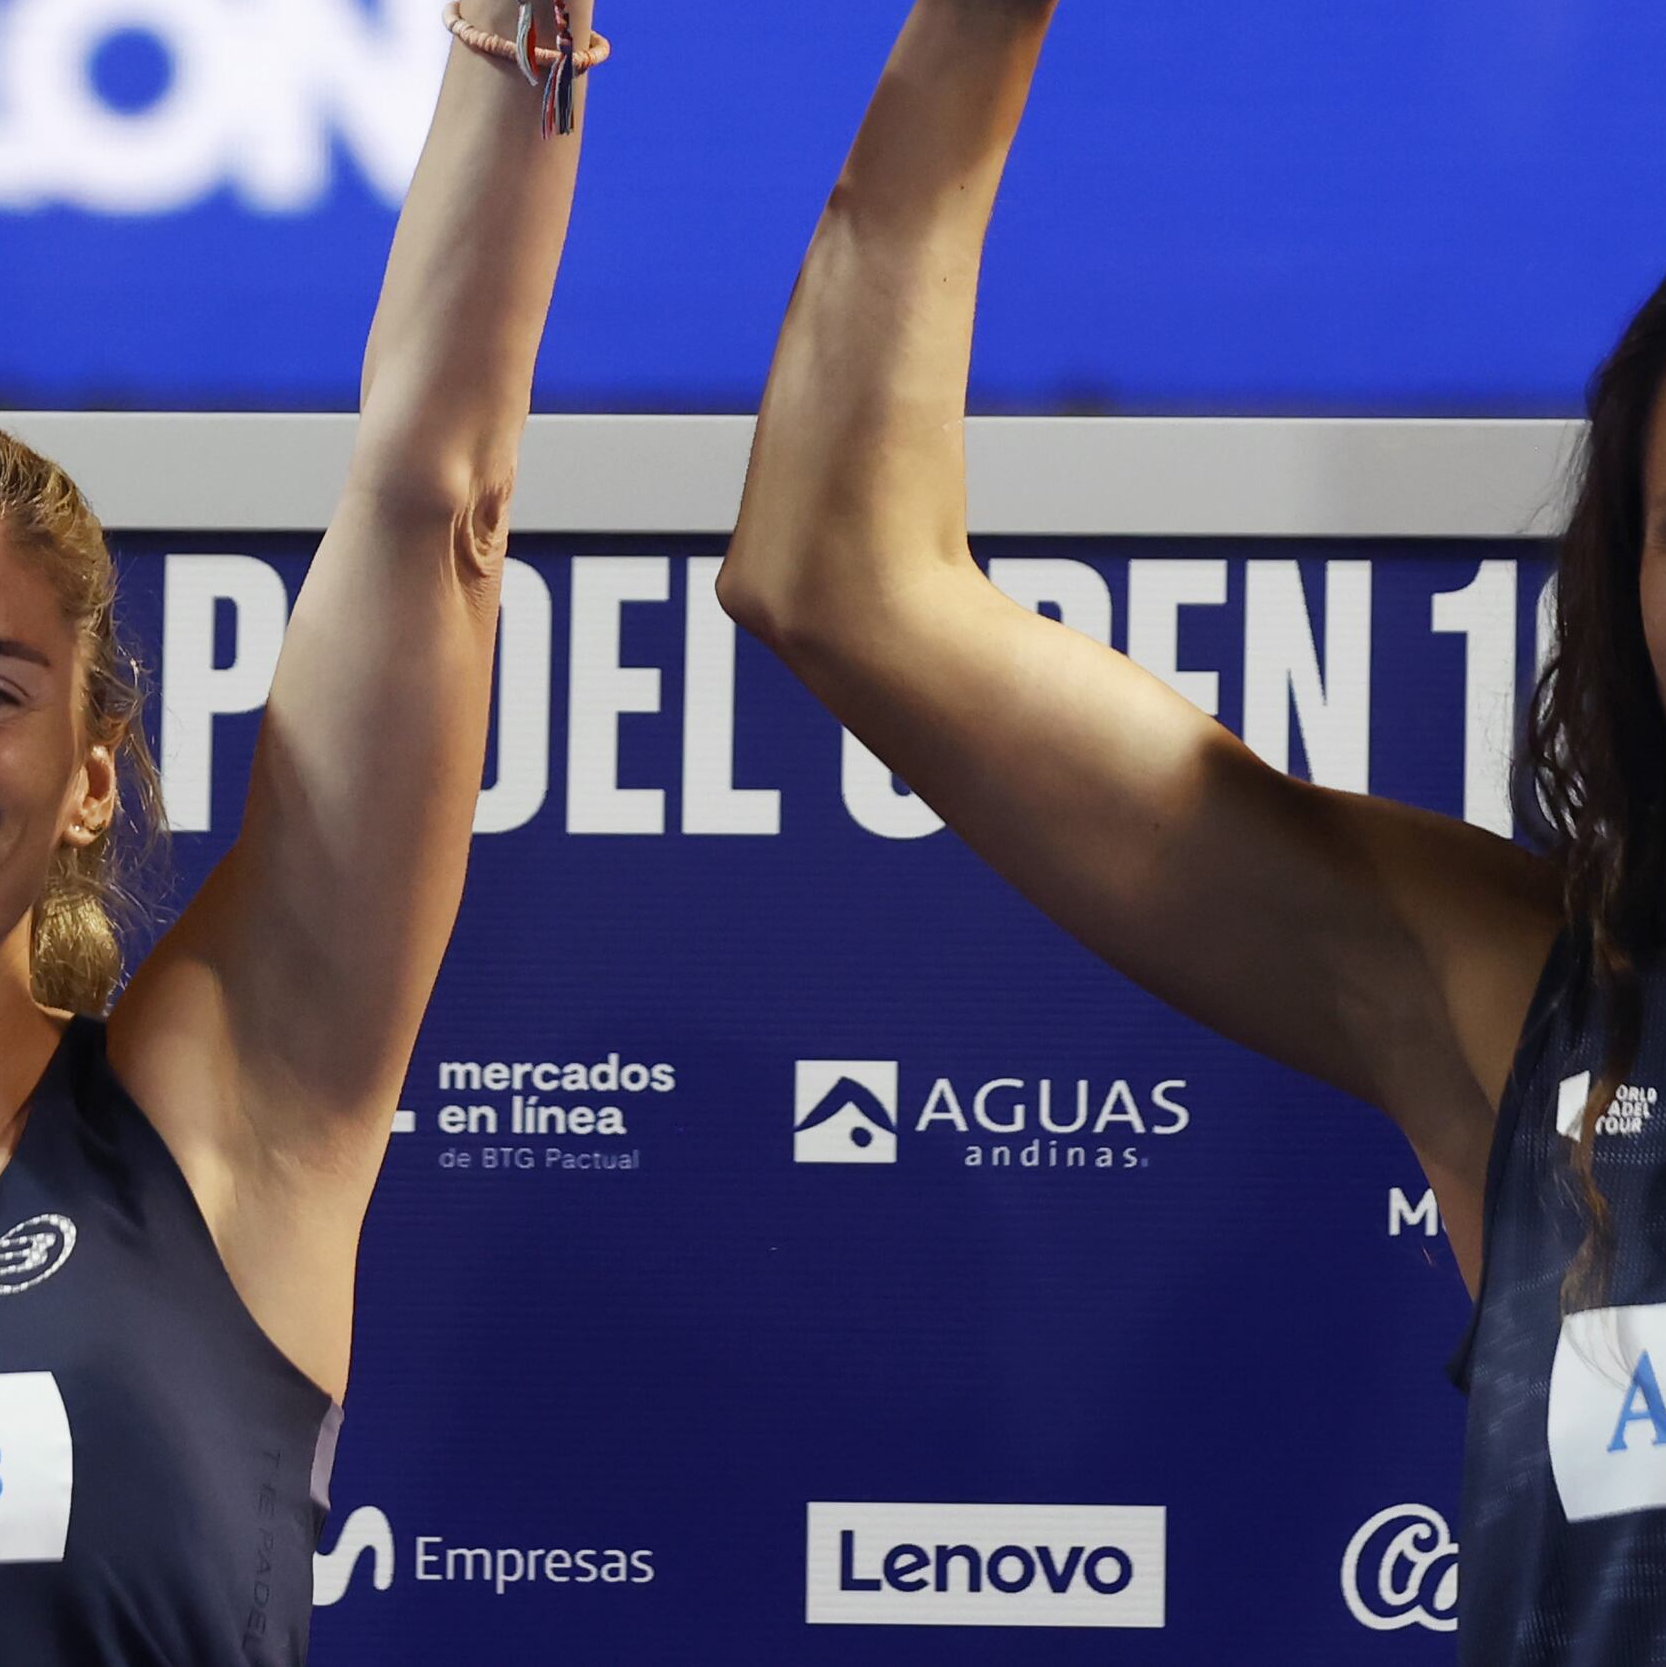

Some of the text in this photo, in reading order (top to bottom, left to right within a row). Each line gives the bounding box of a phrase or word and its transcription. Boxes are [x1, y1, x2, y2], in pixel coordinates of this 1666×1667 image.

[161, 554, 781, 835] PDEL
[439, 1052, 676, 1091] mercados
[915, 1078, 1190, 1134] AGUAS
[1607, 1100, 1651, 1119] ADEL
[1615, 1084, 1658, 1105] ORLD
[438, 1095, 627, 1134] en línea
[439, 1147, 640, 1170] de BTG Pactual
[415, 1536, 655, 1594] Empresas
[838, 1530, 1133, 1596] Lenovo
